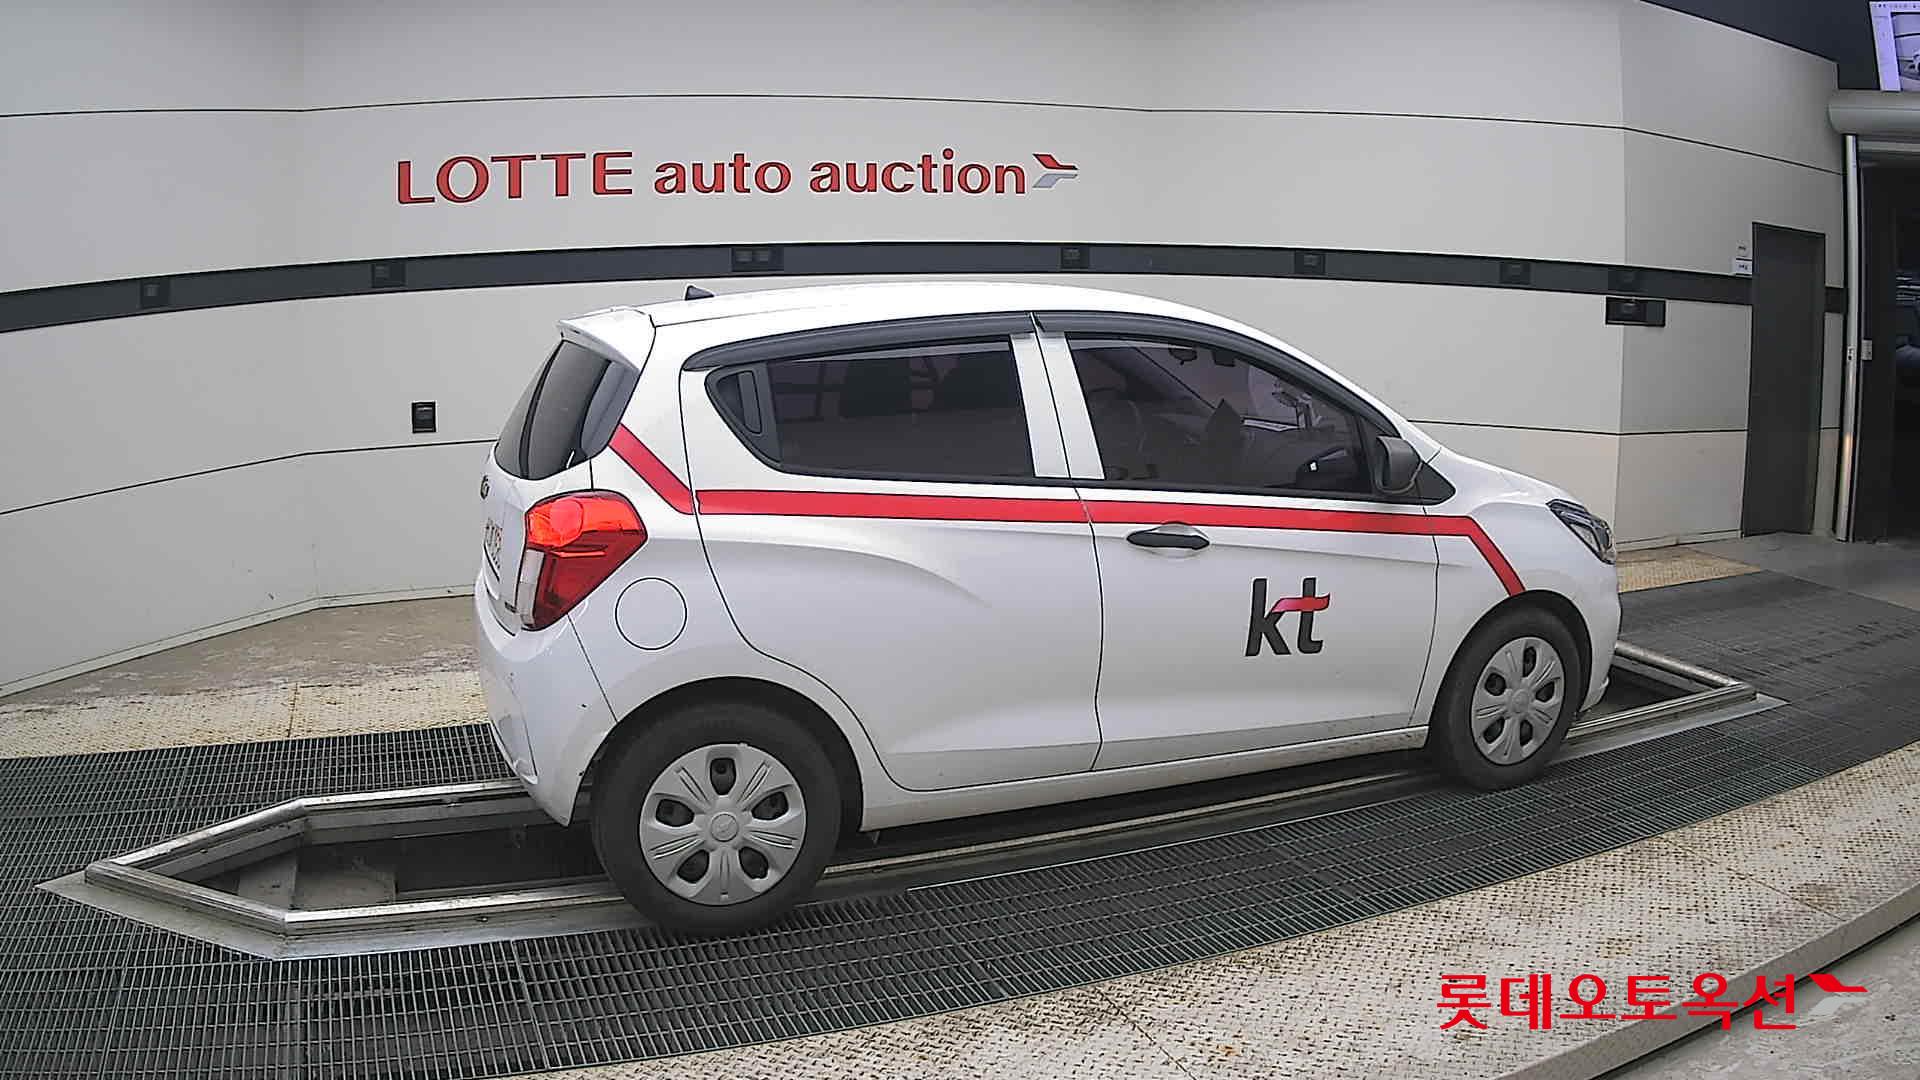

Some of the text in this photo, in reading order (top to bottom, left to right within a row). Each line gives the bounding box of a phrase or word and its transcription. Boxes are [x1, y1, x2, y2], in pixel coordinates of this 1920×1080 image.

[397, 148, 1026, 205] LOTTE auto auction
[1245, 577, 1331, 657] kt
